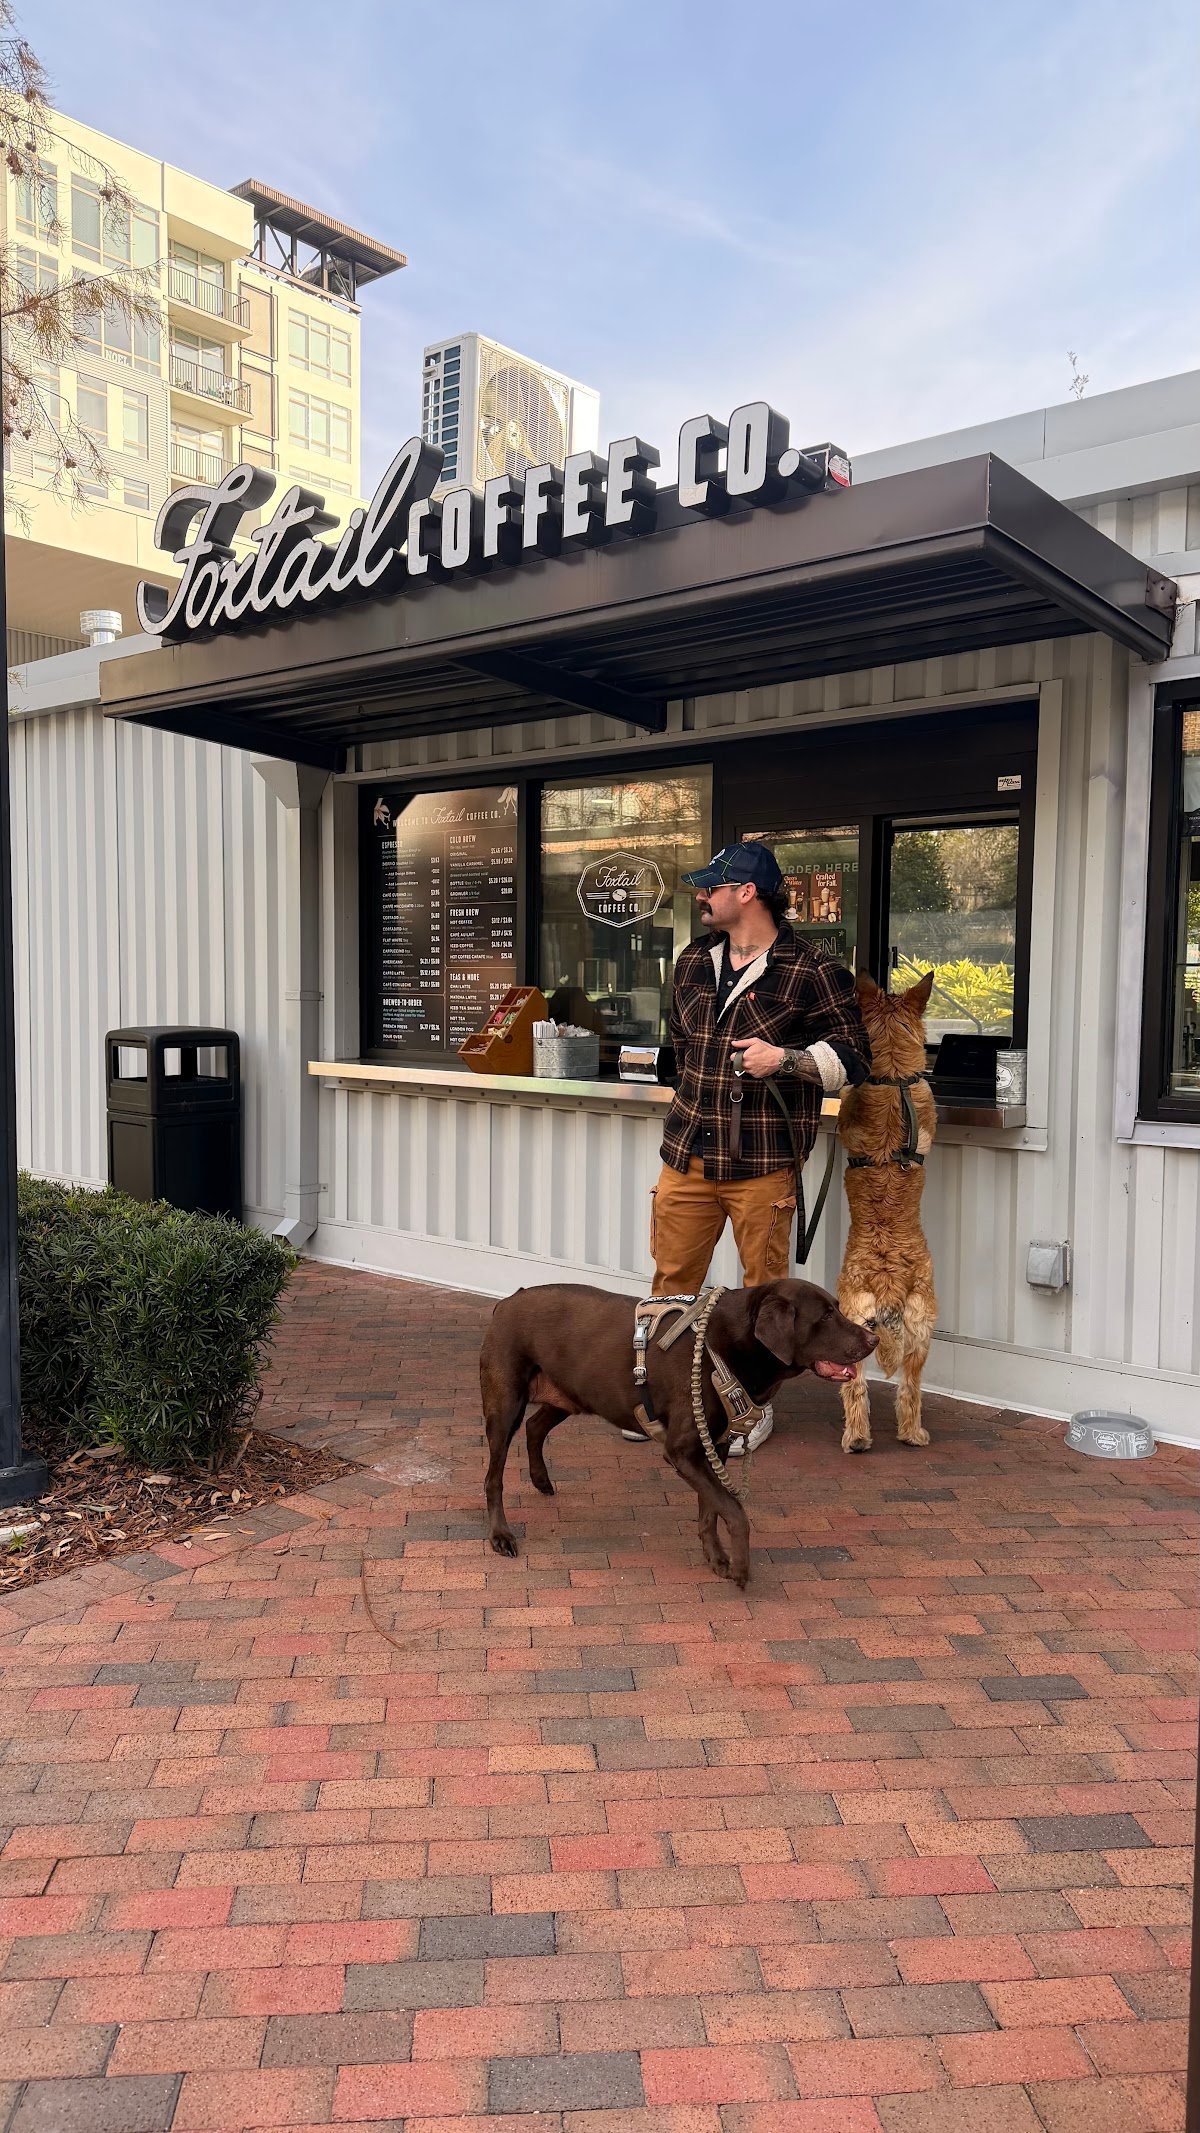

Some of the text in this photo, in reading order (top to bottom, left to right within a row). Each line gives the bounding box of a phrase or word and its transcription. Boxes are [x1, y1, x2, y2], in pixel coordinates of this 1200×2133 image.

[105, 349, 129, 366] NOEL
[137, 402, 802, 637] Foxtail COFFEE CO.
[430, 807, 465, 824] Foxtail
[466, 811, 488, 821] COFFEE
[449, 834, 477, 844] COLD BREW
[825, 862, 859, 873] HERE
[816, 873, 836, 881] Crafted
[595, 866, 645, 914] Foxtail COFFEE CO.
[449, 908, 480, 917] FRESH BREW
[449, 973, 461, 981] TEAS
[466, 973, 480, 981] MORE
[383, 998, 423, 1007] BREWED-TO-ORDER
